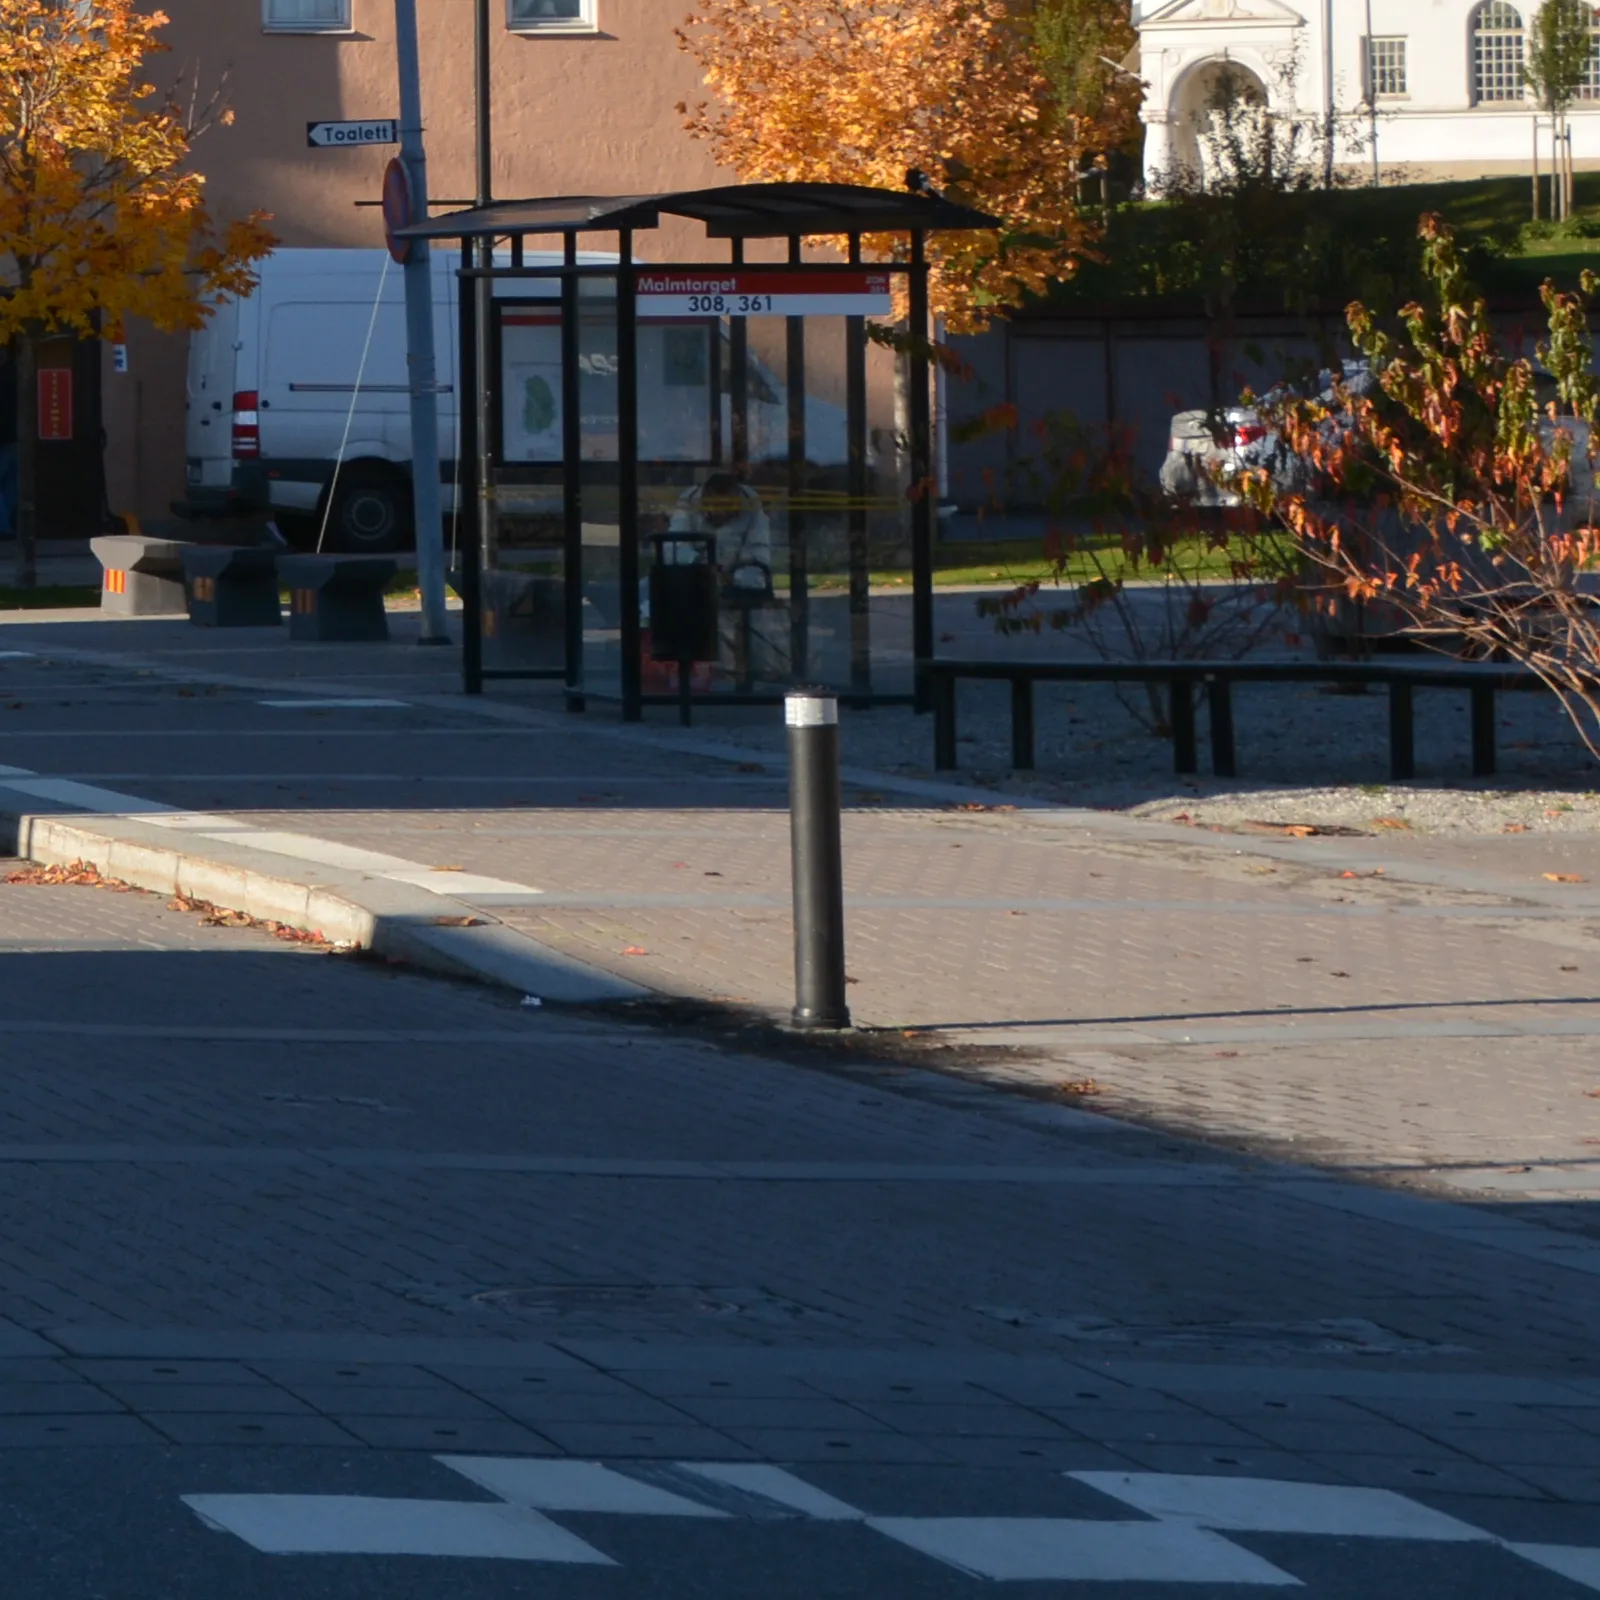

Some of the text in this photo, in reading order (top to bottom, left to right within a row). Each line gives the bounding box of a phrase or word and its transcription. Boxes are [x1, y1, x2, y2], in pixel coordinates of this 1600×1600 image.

[324, 125, 388, 142] Toalett
[637, 277, 737, 295] Malmtorget
[688, 295, 772, 314] 308, 361
